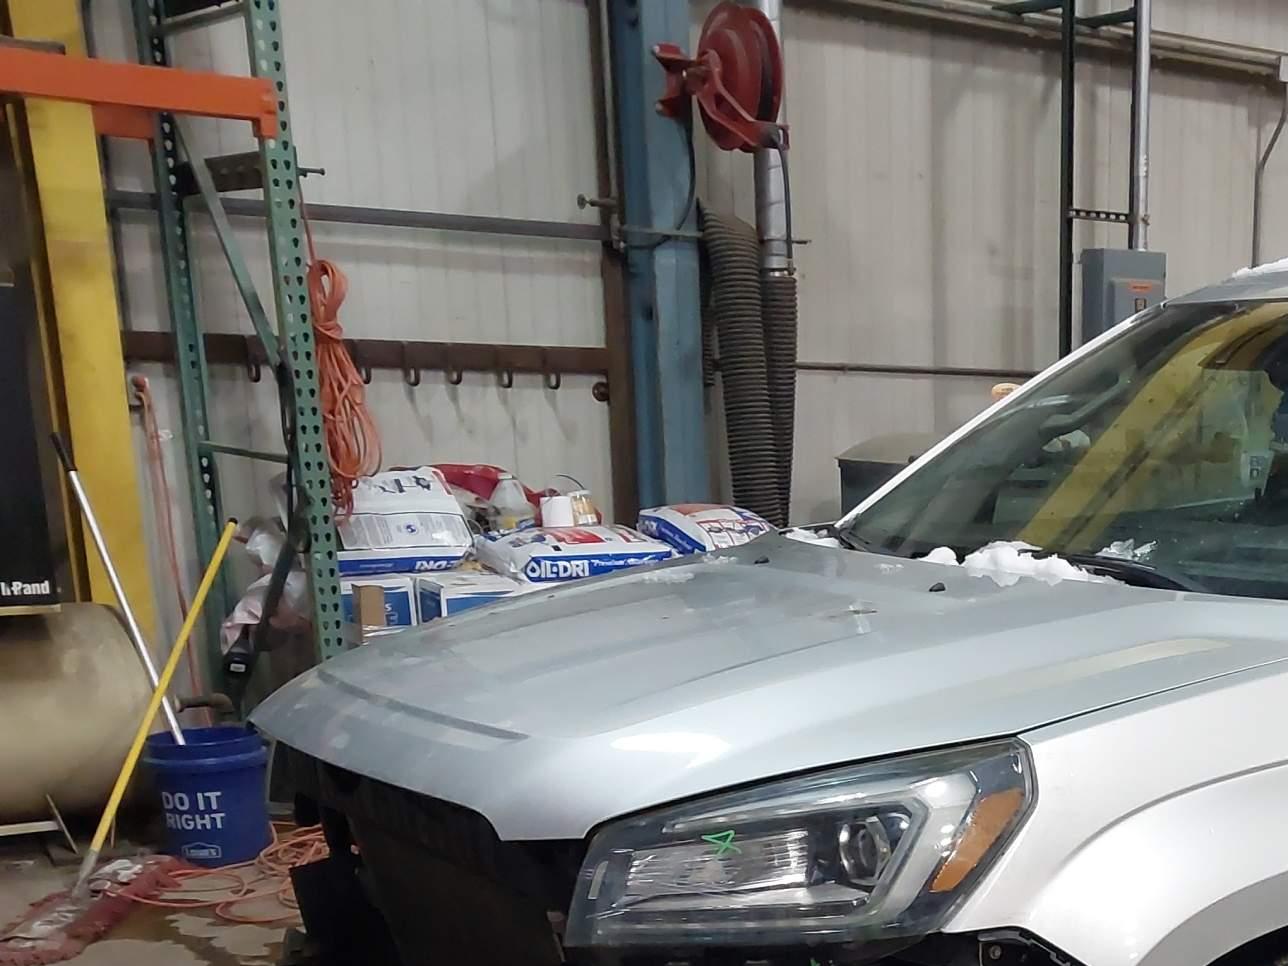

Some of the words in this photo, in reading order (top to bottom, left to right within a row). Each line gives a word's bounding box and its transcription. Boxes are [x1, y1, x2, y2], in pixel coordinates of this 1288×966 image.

[526, 559, 590, 578] OIL-DRI
[162, 791, 190, 811] DO
[196, 791, 222, 810] IT
[166, 812, 226, 830] RIGHT
